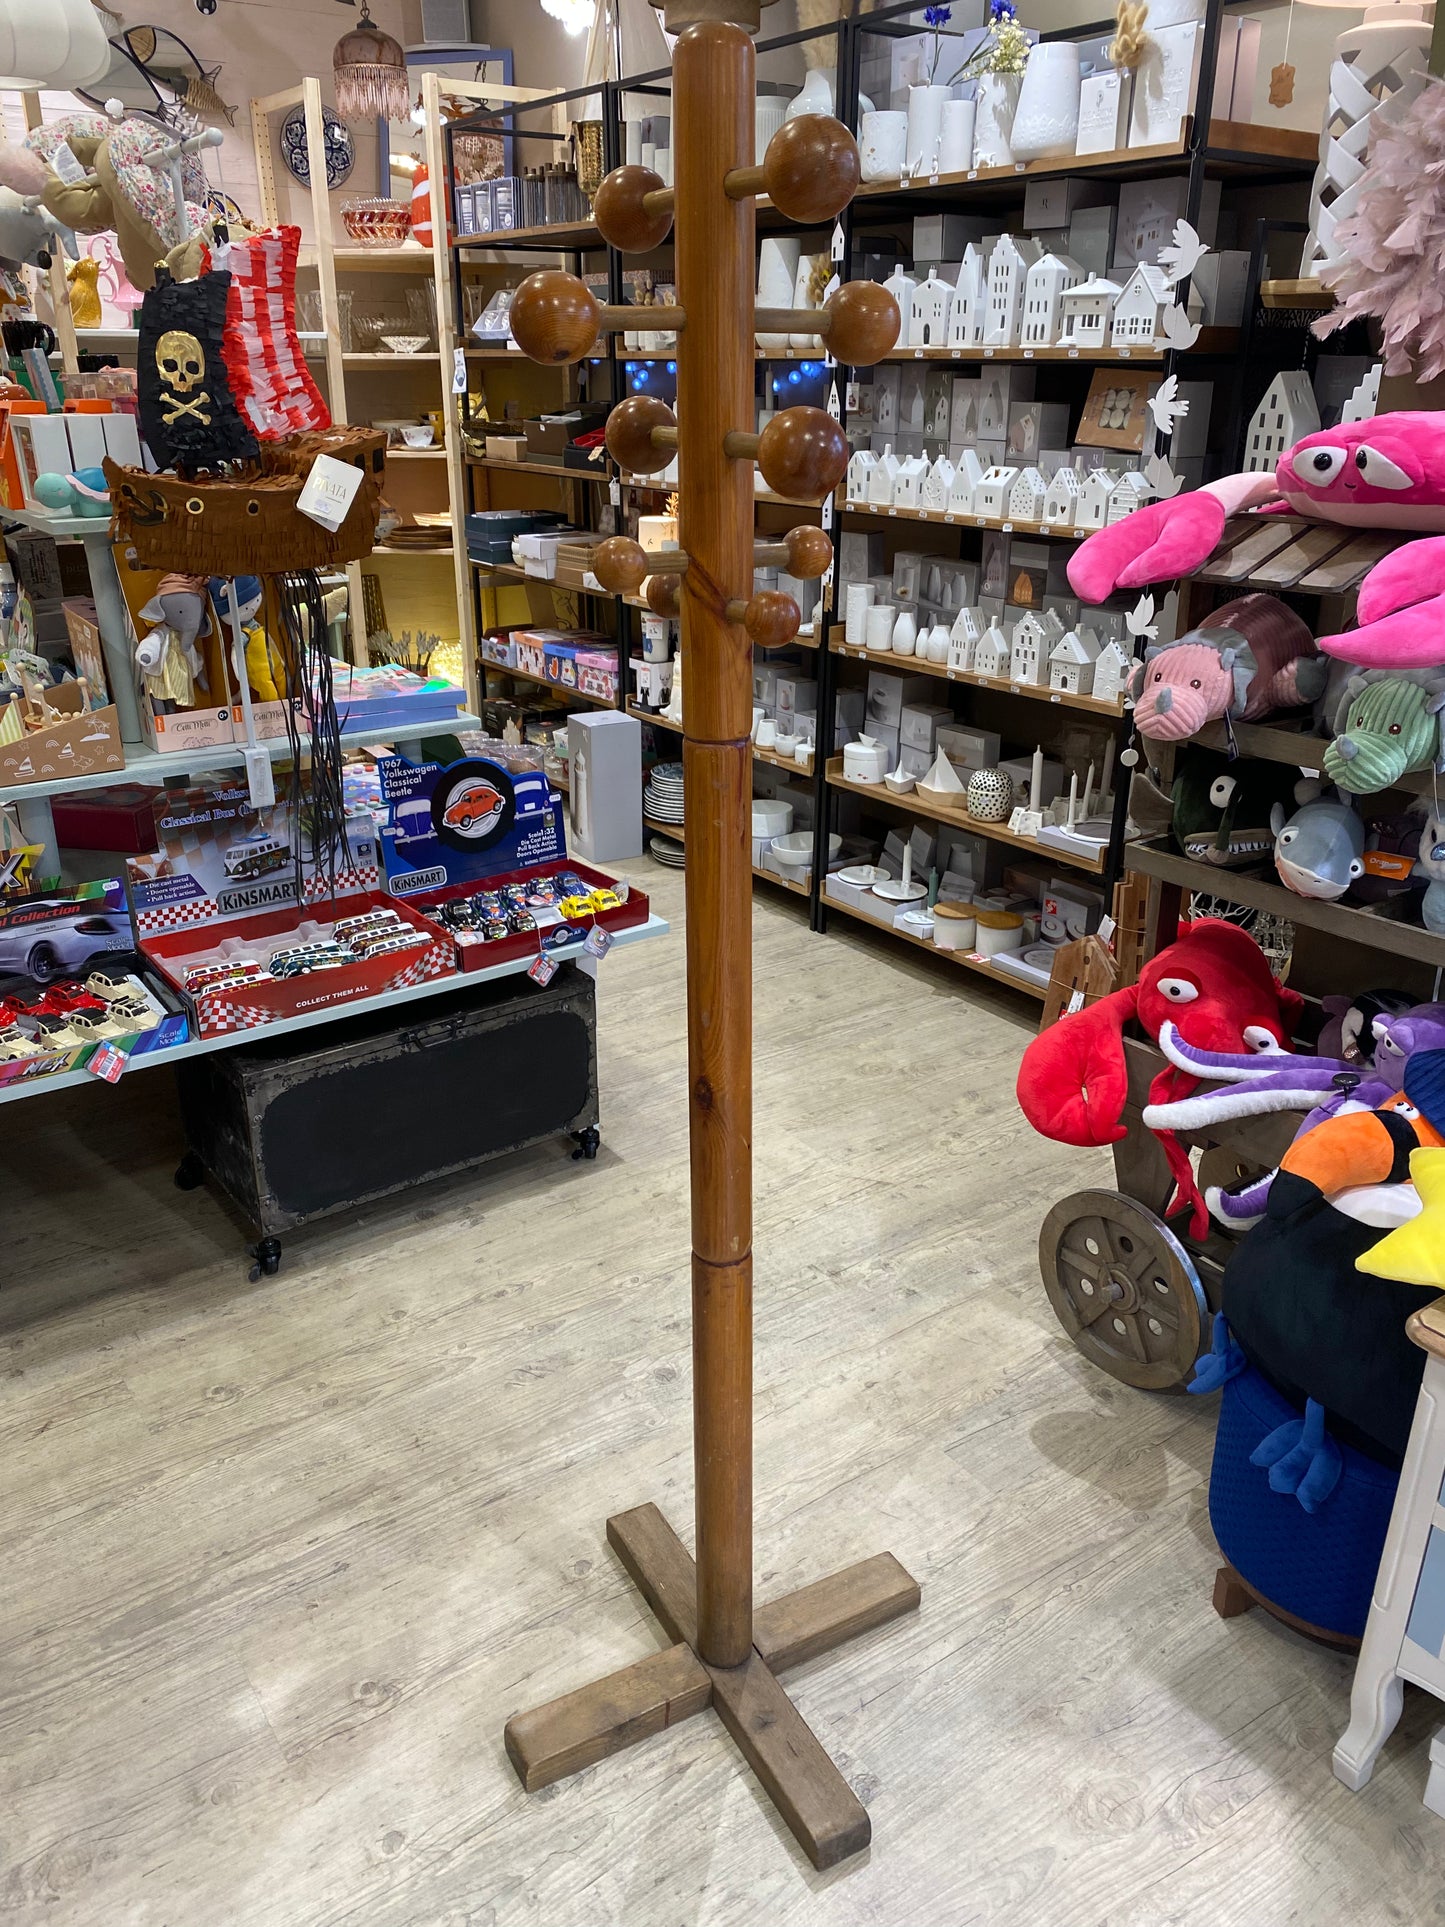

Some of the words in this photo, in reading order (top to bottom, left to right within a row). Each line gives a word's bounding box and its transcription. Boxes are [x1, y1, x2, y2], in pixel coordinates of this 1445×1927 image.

[380, 758, 402, 771] 1967
[382, 764, 438, 779] Volkswagen
[383, 774, 422, 789] Classical
[384, 786, 413, 799] Beetle
[160, 812, 212, 829] Classical
[213, 808, 236, 819] Bus
[173, 876, 189, 884] metal
[150, 888, 167, 896] Doors
[168, 882, 196, 893] openable
[178, 889, 197, 898] action
[11, 904, 81, 925] Collection
[295, 994, 331, 1008] COLLECT
[332, 988, 354, 999] THEM
[355, 984, 369, 992] ALL
